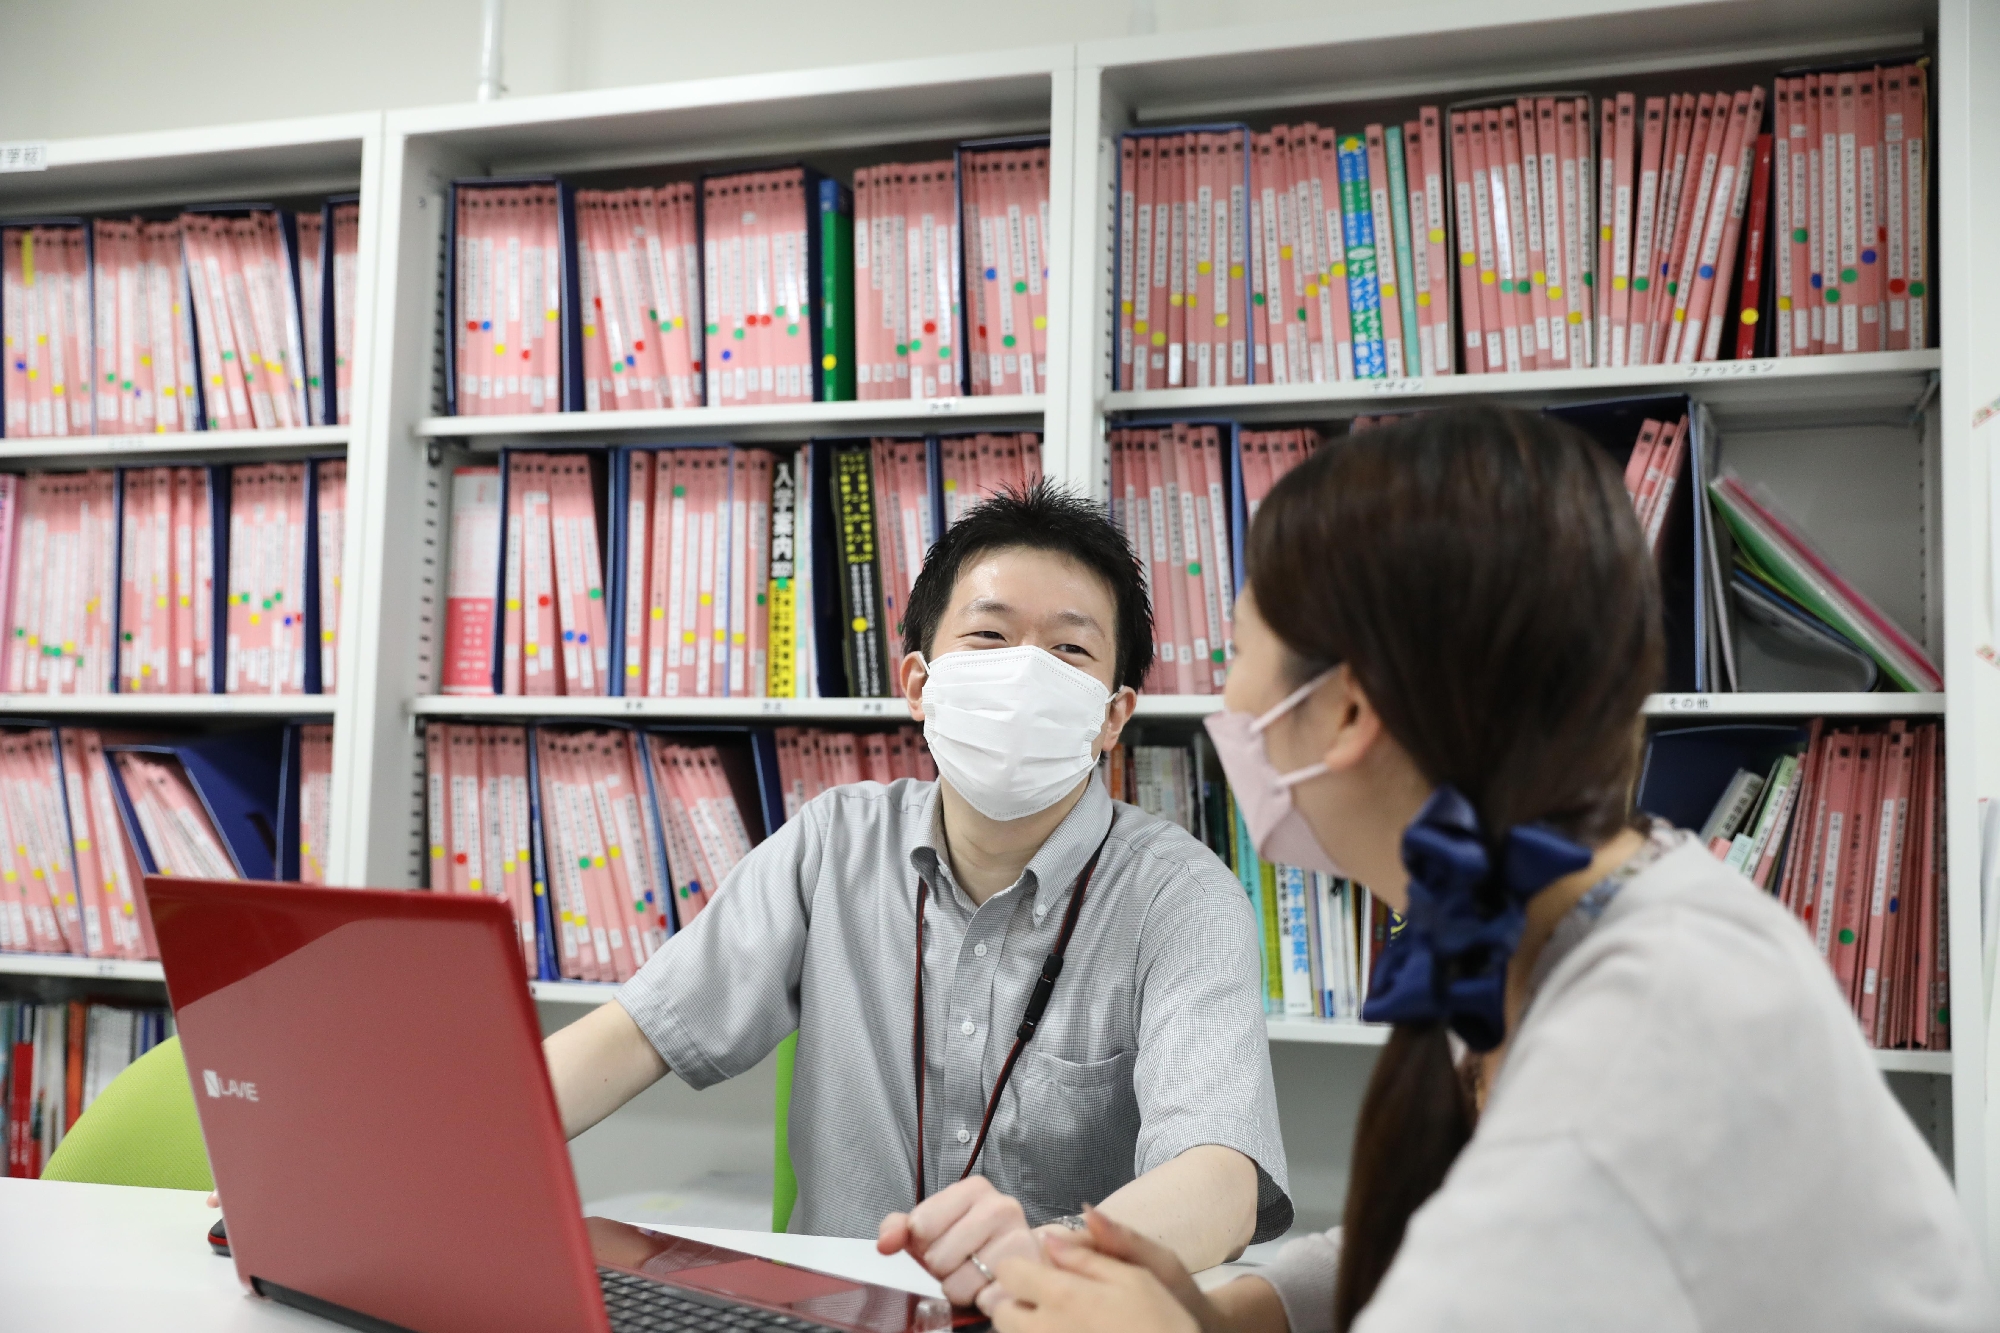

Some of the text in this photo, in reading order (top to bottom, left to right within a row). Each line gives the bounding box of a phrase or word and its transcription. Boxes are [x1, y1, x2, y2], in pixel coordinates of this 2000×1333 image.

[1687, 361, 1776, 377] ファッション
[771, 461, 794, 562] 入学案内
[1669, 697, 1709, 711] その他
[218, 1077, 260, 1103] LAVIE
